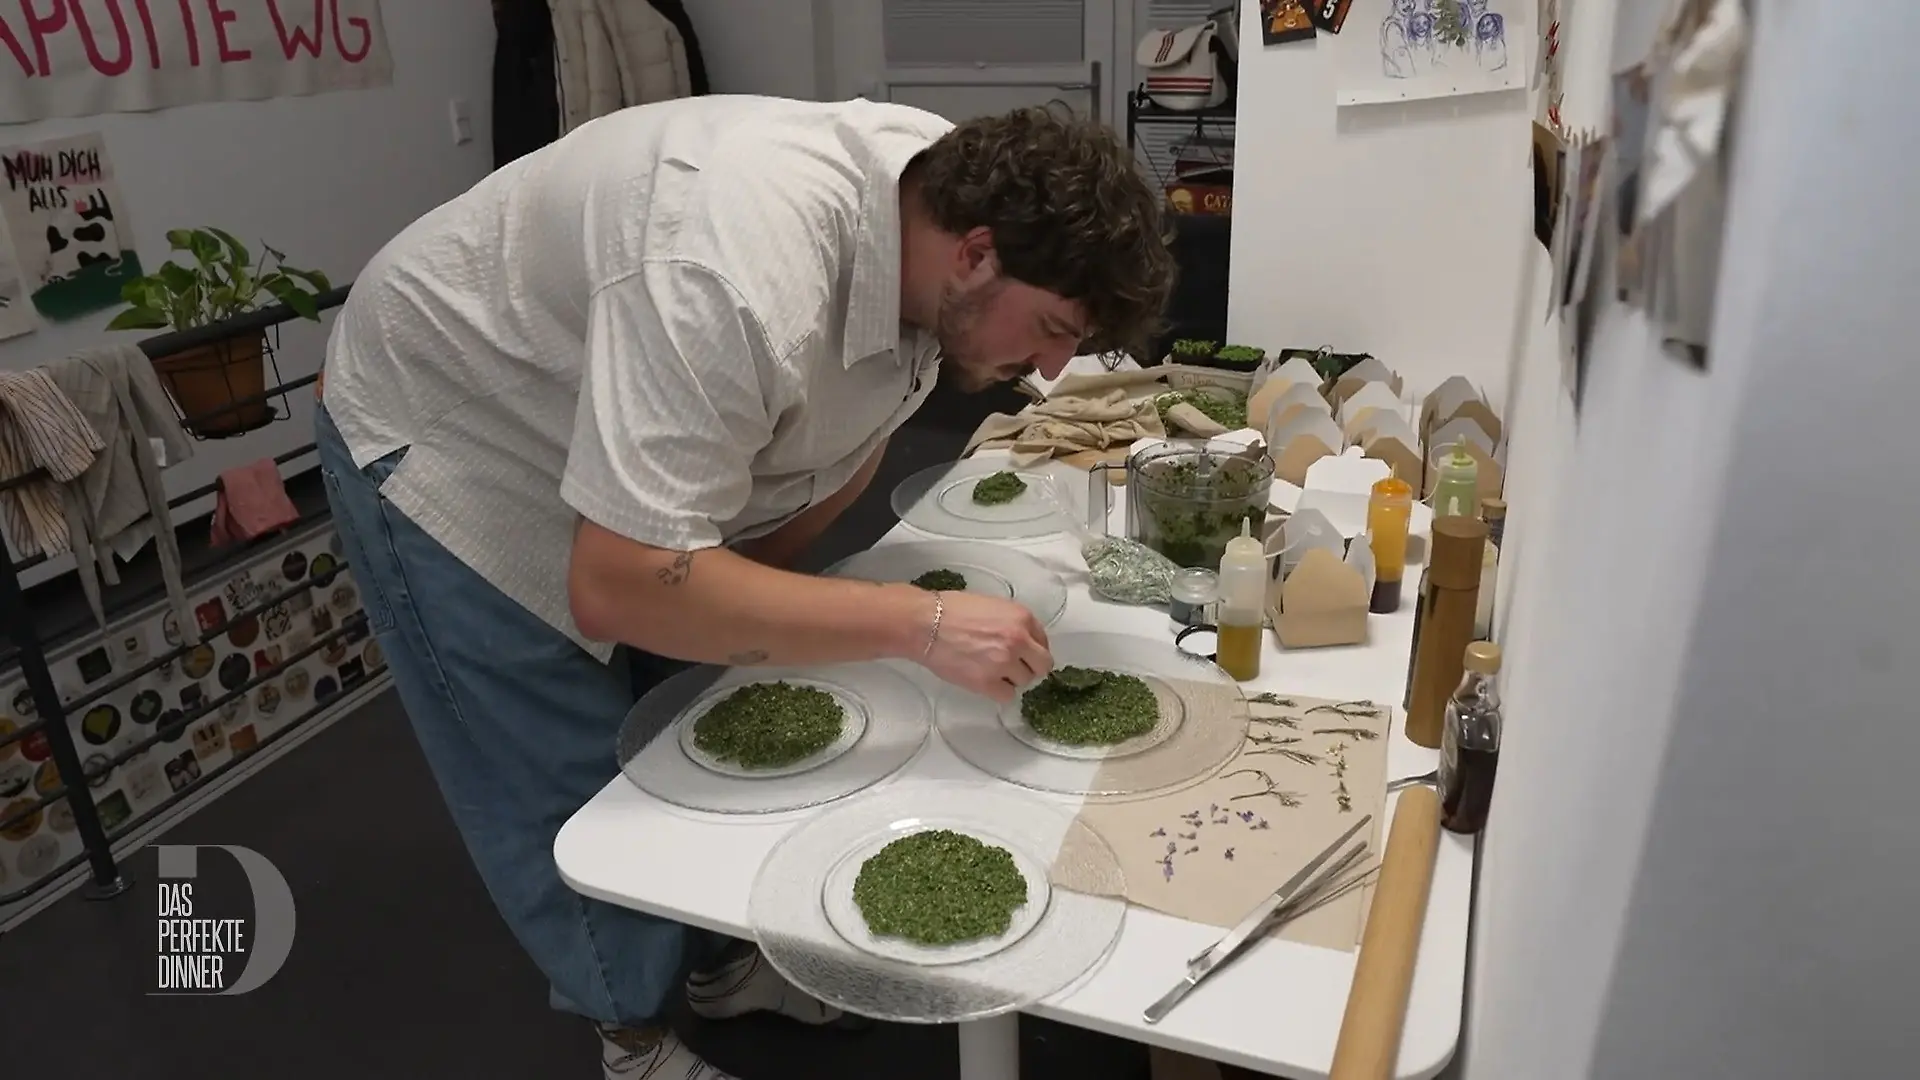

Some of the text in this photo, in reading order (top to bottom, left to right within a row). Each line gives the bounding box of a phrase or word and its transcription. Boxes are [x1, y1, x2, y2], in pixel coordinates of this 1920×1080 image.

[266, 0, 371, 63] WG
[2, 148, 101, 191] MUH DICH
